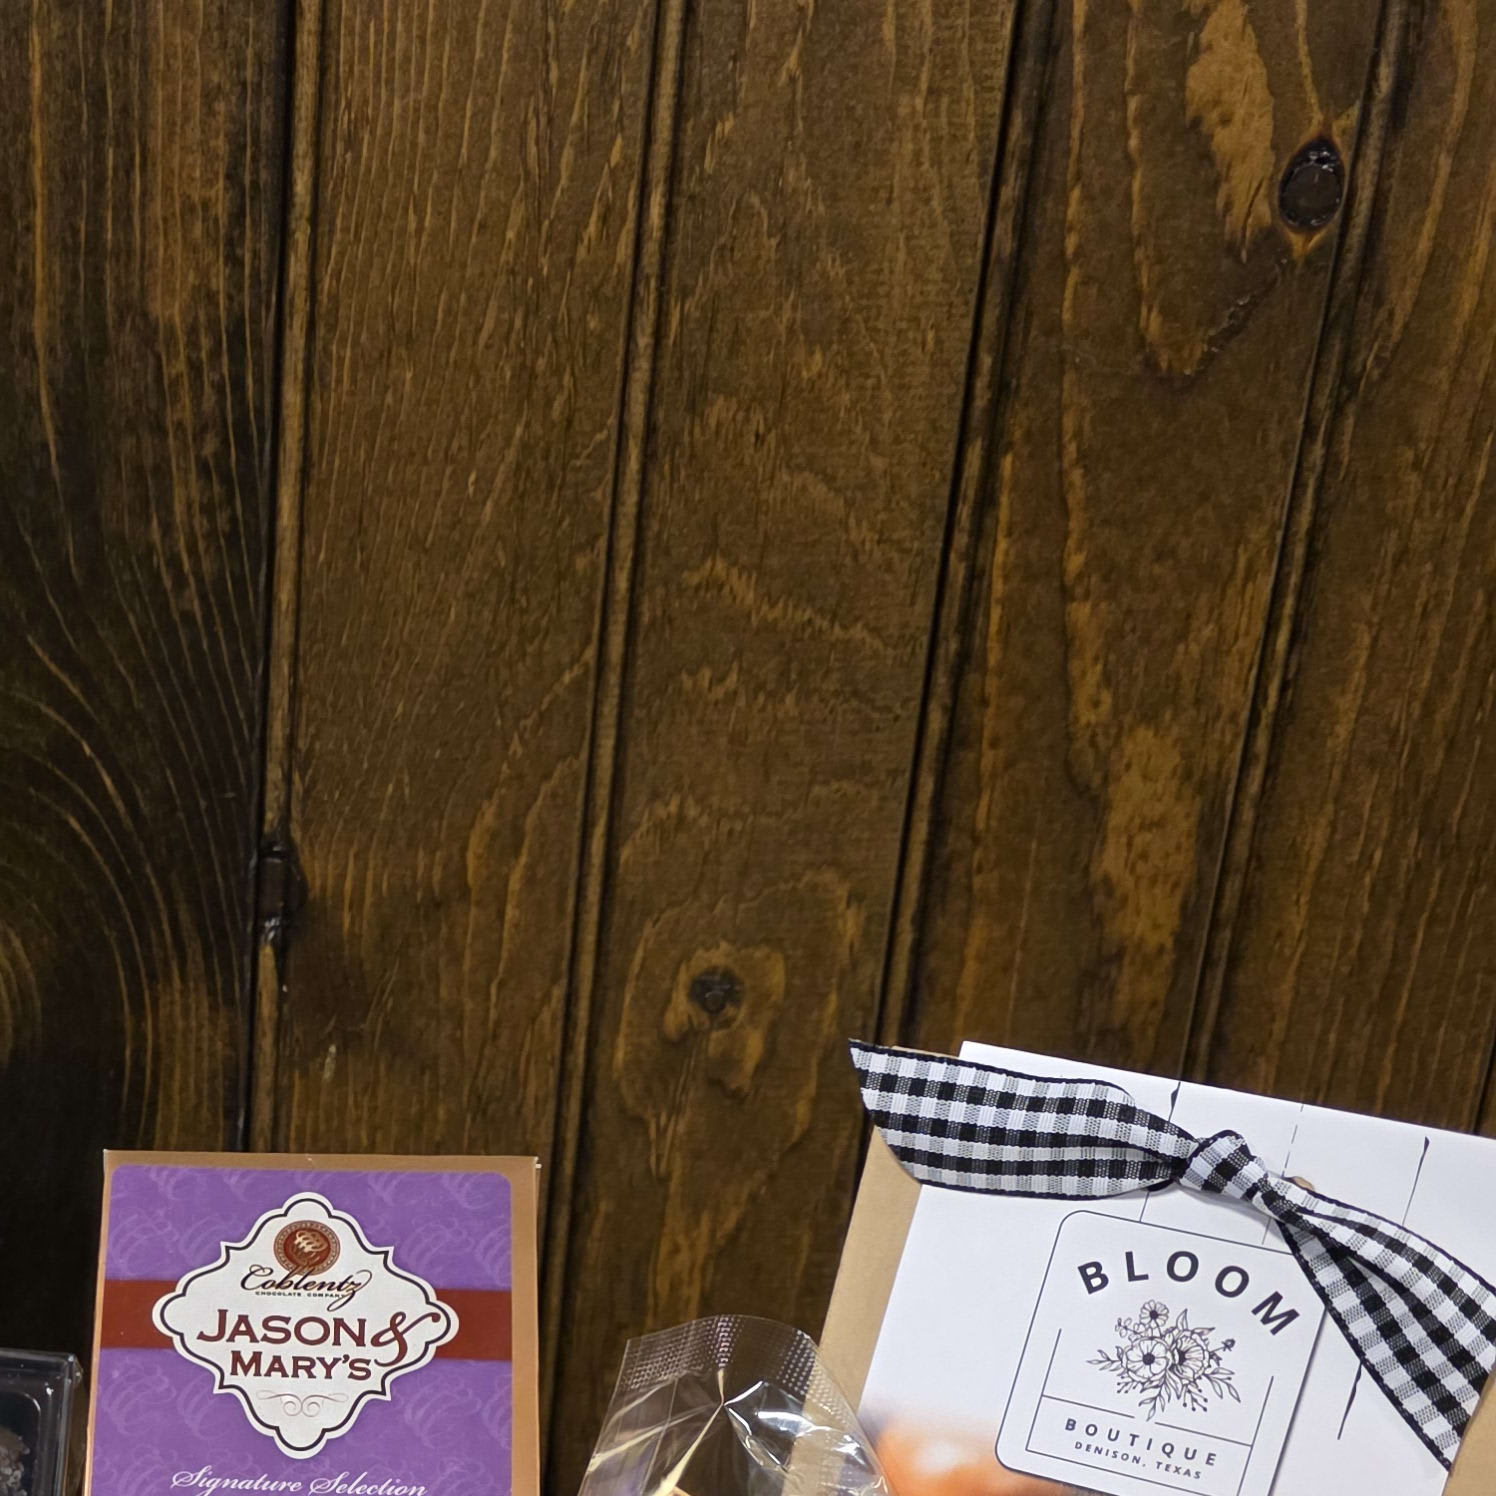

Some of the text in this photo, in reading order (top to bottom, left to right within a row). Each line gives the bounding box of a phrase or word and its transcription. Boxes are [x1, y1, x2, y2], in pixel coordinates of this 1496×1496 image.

[240, 1264, 372, 1312] Coblentz
[1077, 1251, 1300, 1335] BLOOM
[196, 1309, 441, 1367] JASON &
[230, 1350, 372, 1380] MARY'S
[1064, 1418, 1217, 1466] BOUTIQUE
[1075, 1441, 1202, 1480] DENISON, TEXAS
